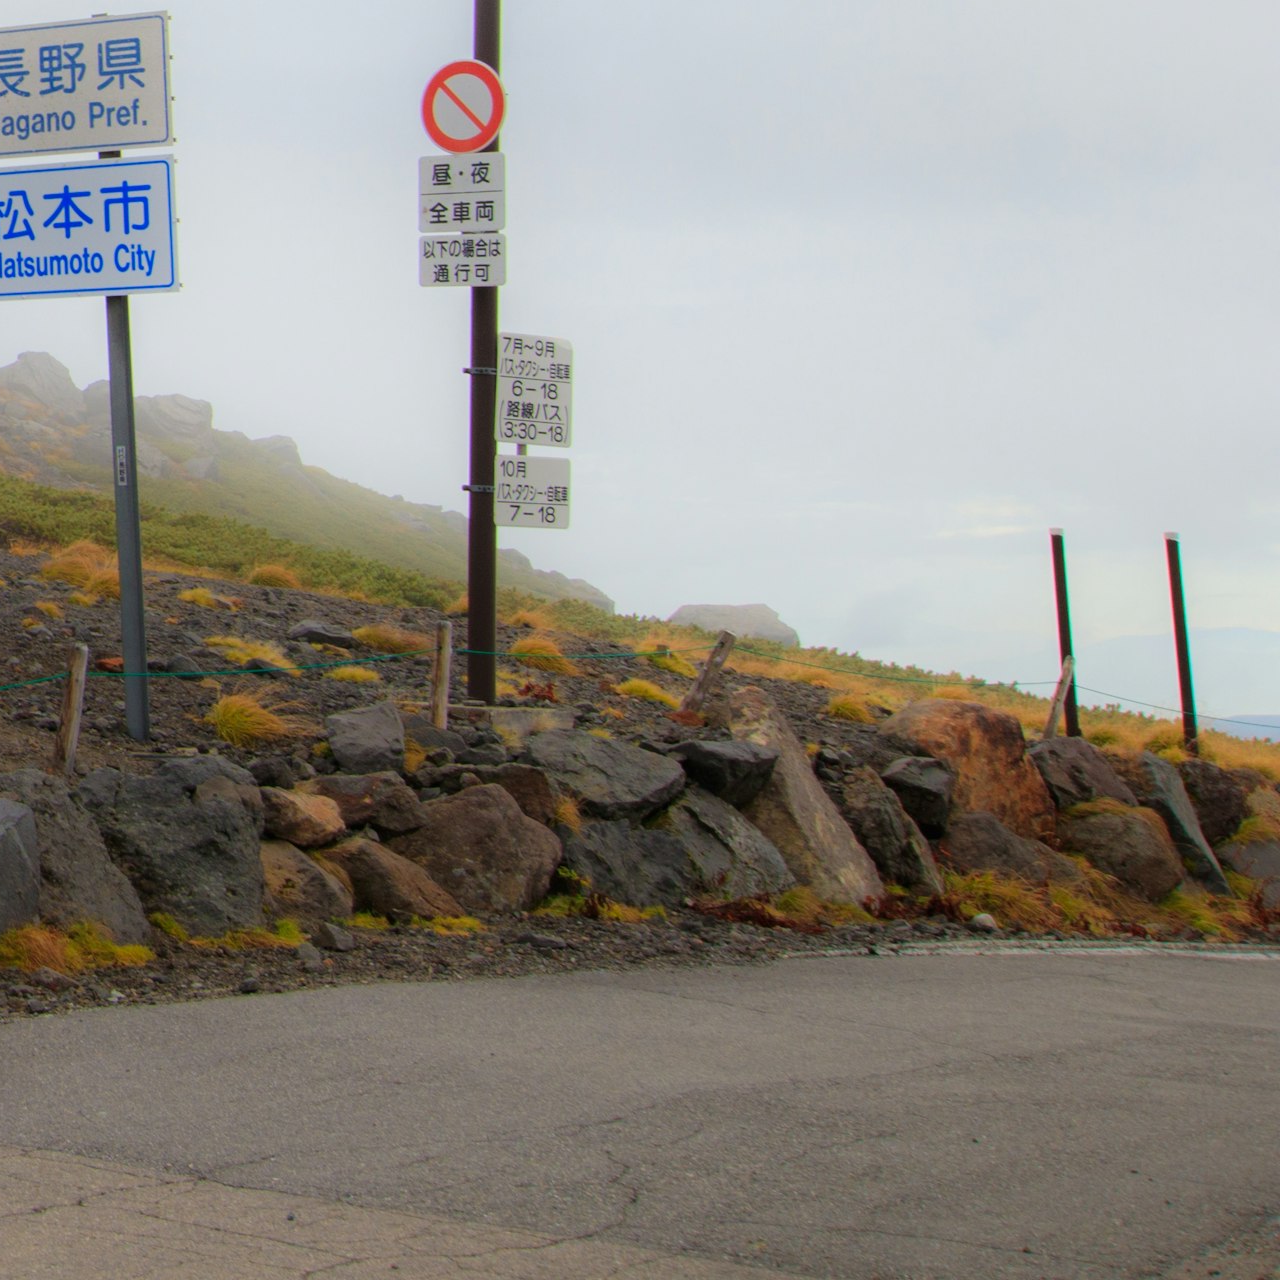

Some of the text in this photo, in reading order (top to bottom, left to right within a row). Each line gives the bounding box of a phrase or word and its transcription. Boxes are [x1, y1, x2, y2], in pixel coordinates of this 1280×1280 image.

[88, 99, 148, 129] Pref.
[432, 161, 490, 186] 昼・夜
[429, 200, 494, 224] 全車両
[113, 243, 156, 277] City
[423, 238, 501, 259] 以下の場合は
[433, 263, 491, 283] 通行可
[500, 460, 526, 478] 10月
